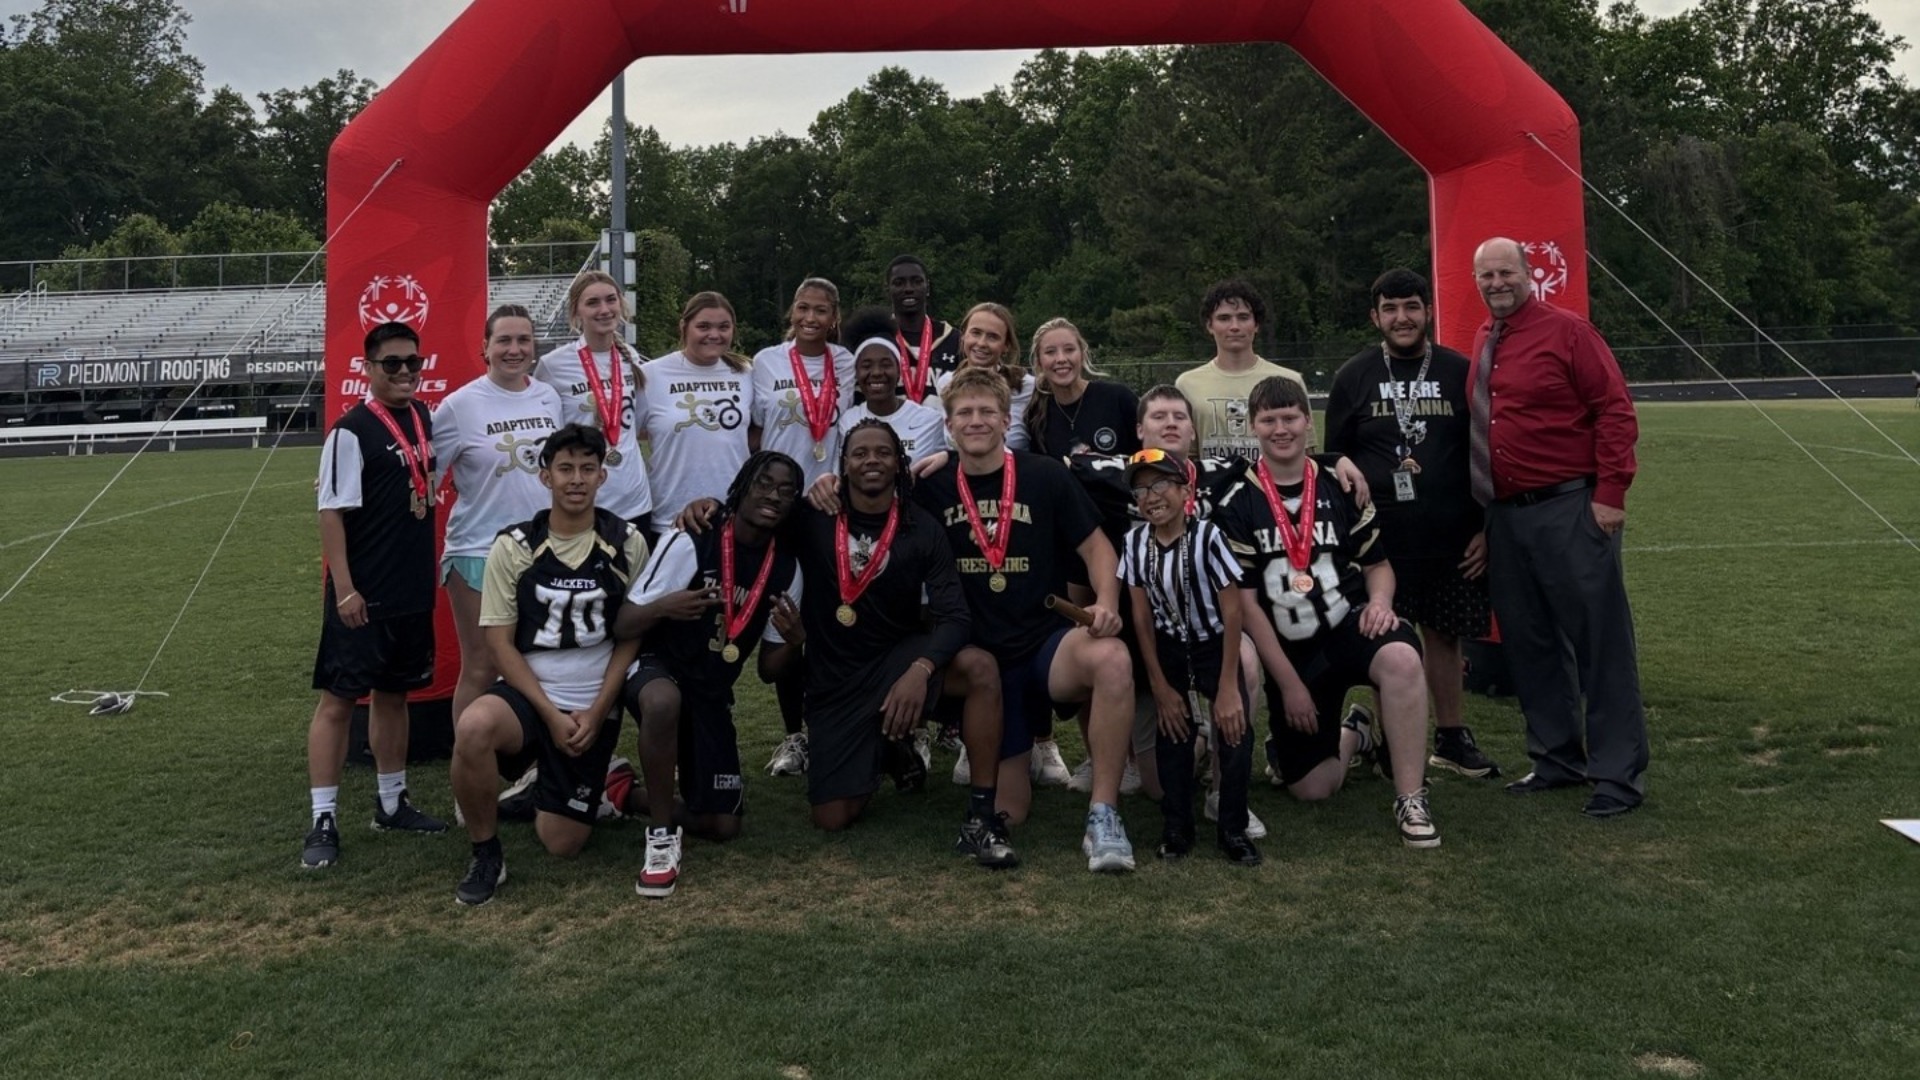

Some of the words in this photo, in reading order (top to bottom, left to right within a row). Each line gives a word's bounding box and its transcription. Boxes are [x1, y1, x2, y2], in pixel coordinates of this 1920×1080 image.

[68, 361, 151, 384] PIEDMONT
[160, 359, 231, 381] ROOFING
[341, 377, 449, 399] Olyics
[669, 381, 725, 394] ADAPTIVE
[728, 381, 741, 392] PE
[1379, 381, 1406, 399] WE
[1371, 401, 1395, 417] T.L.
[486, 417, 544, 436] ADAPTIVE
[550, 578, 597, 589] JACKETS
[1262, 552, 1351, 641] 81
[532, 583, 608, 648] 70
